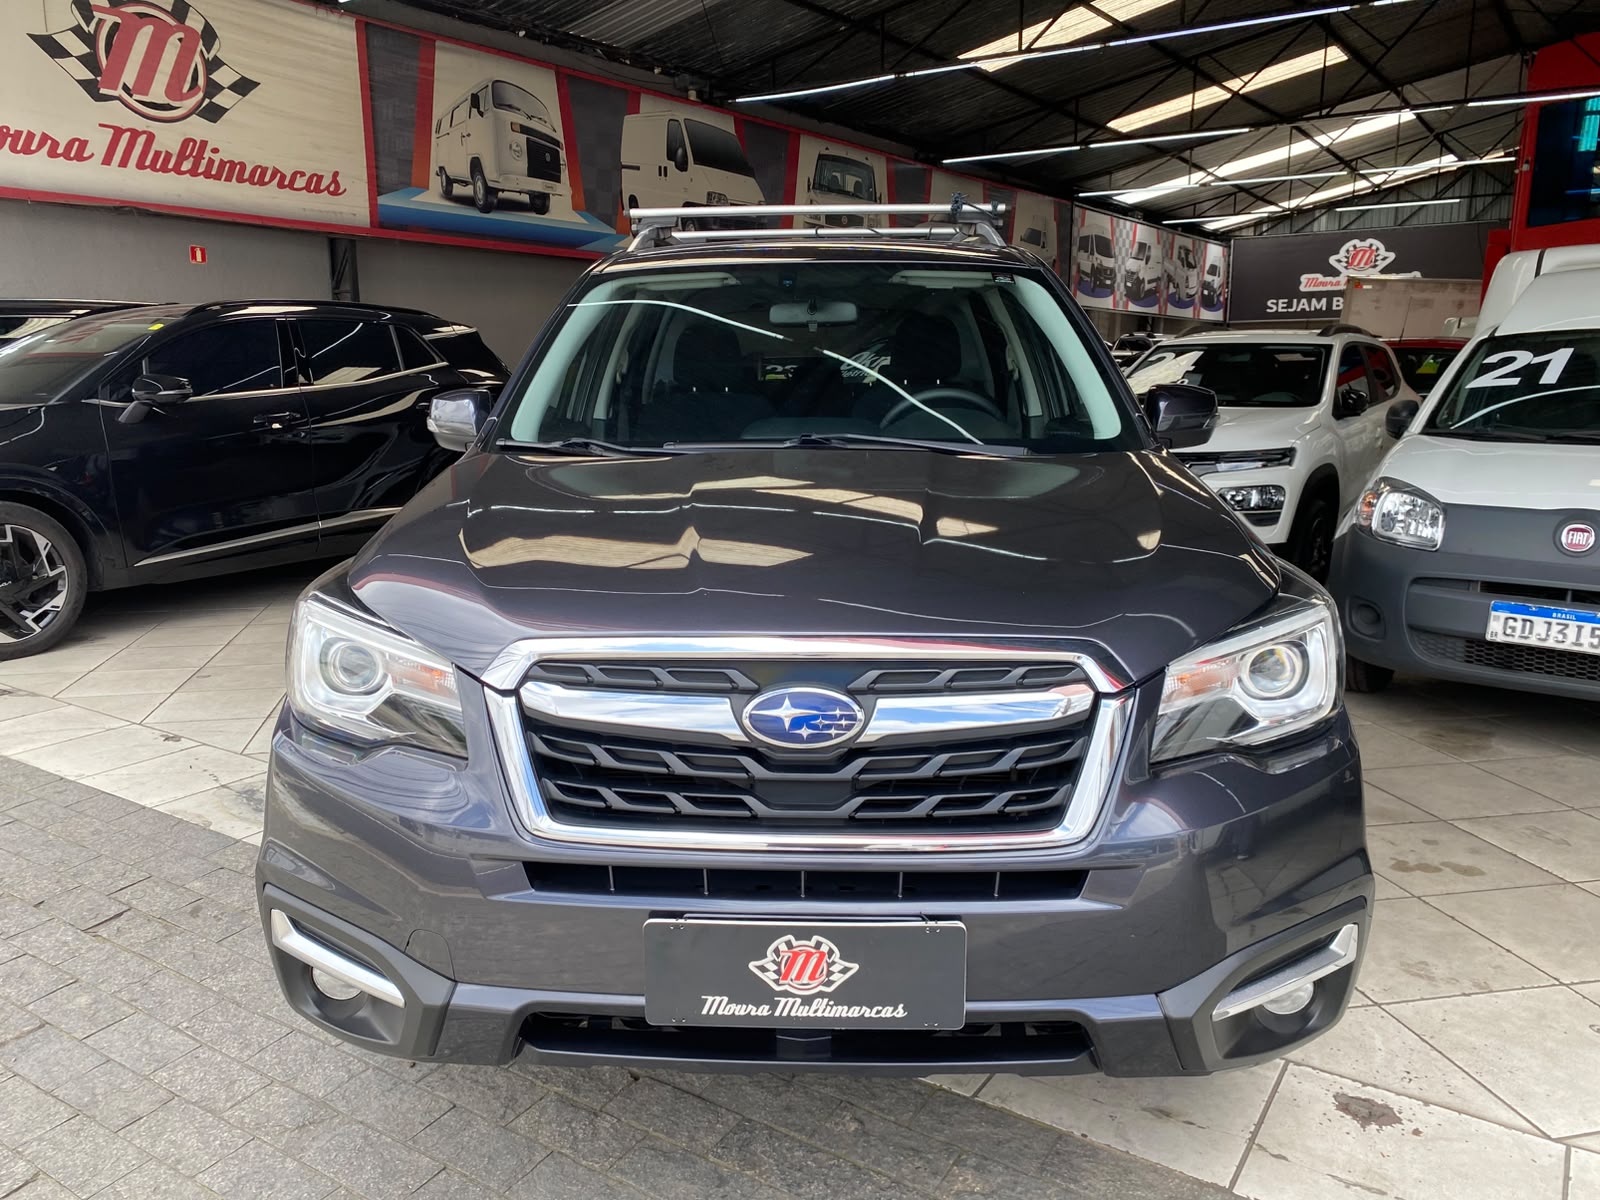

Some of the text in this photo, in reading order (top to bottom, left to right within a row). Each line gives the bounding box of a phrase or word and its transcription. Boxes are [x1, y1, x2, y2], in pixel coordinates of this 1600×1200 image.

[0, 123, 347, 196] oura Multimarcas
[1303, 277, 1342, 289] Moura
[1266, 297, 1327, 313] SEJAM
[1465, 347, 1575, 389] 21
[1567, 530, 1591, 545] FIAT
[1551, 612, 1577, 621] BRASIL
[1502, 616, 1600, 648] GDJ3I5
[701, 995, 908, 1019] Moura Multimarcas
